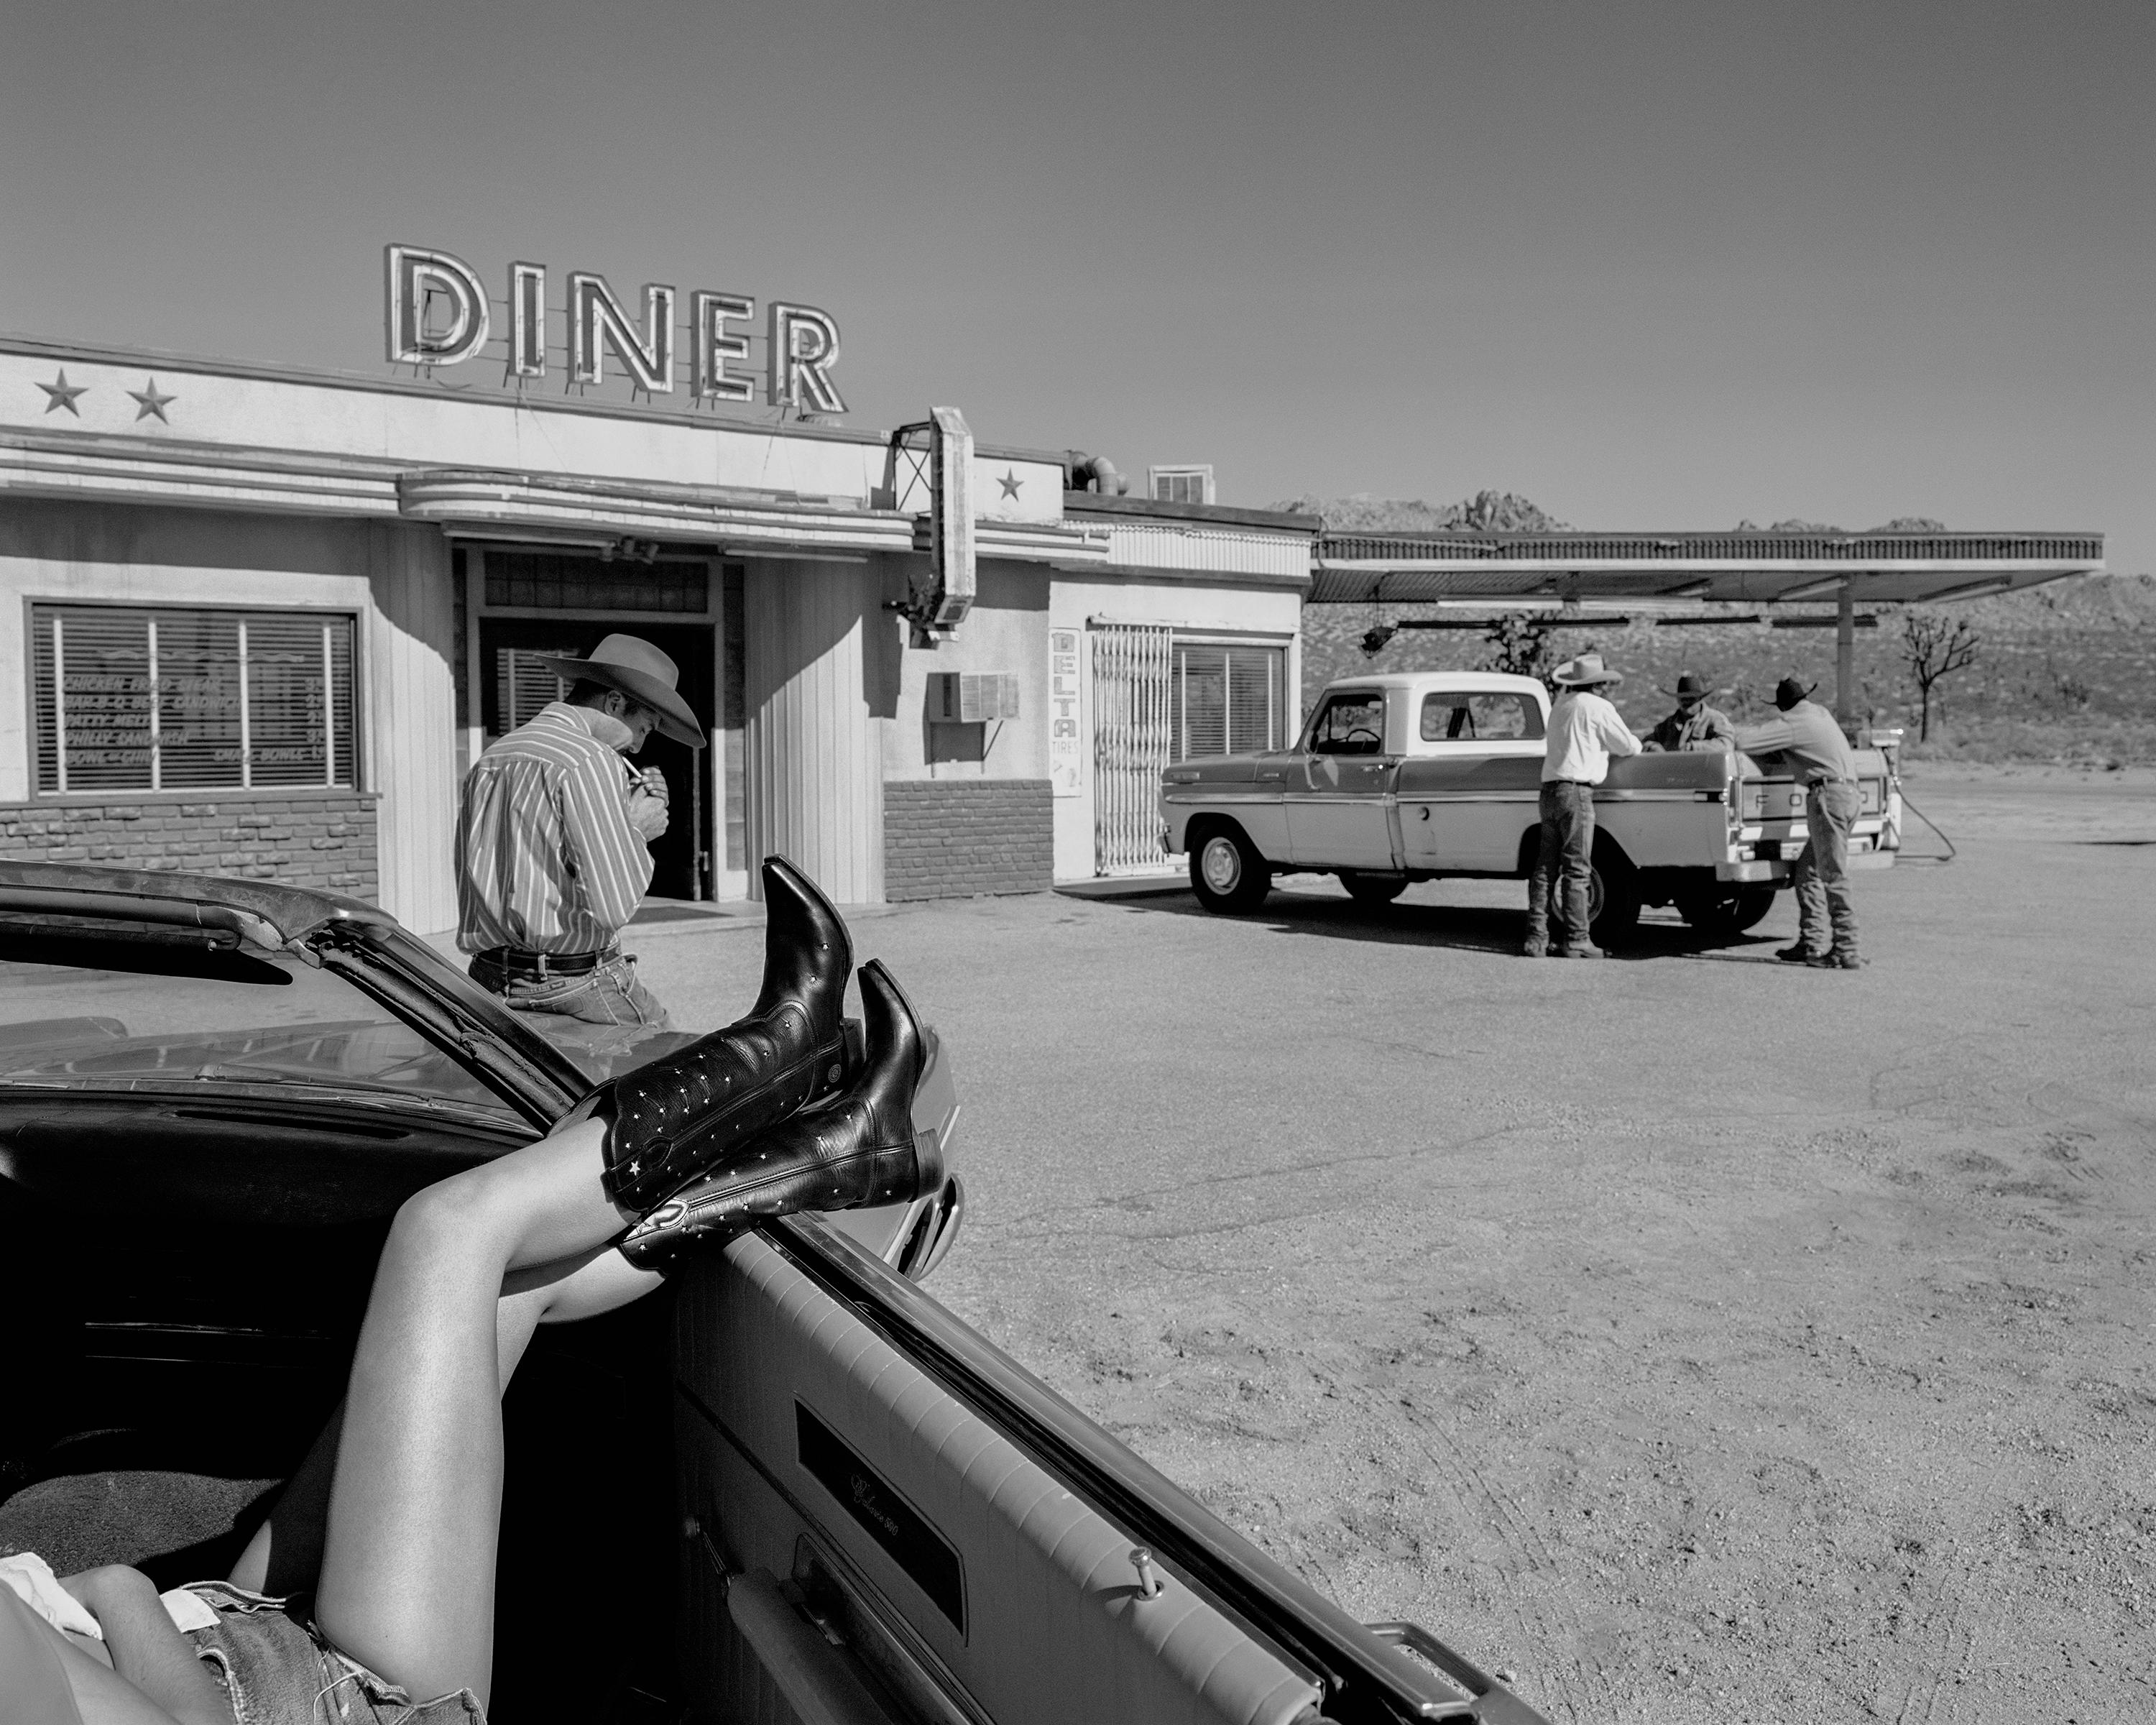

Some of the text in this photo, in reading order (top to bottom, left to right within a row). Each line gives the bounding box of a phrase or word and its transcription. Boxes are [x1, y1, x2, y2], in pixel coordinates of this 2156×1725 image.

[384, 243, 849, 413] DINER
[1052, 632, 1076, 737] DELTA
[66, 714, 111, 727] PATTY
[114, 714, 150, 727] MELT
[66, 730, 113, 746] PHILLY
[1052, 741, 1079, 754] TIRES
[1756, 791, 1868, 808] FOD
[884, 1517, 899, 1536] 500
